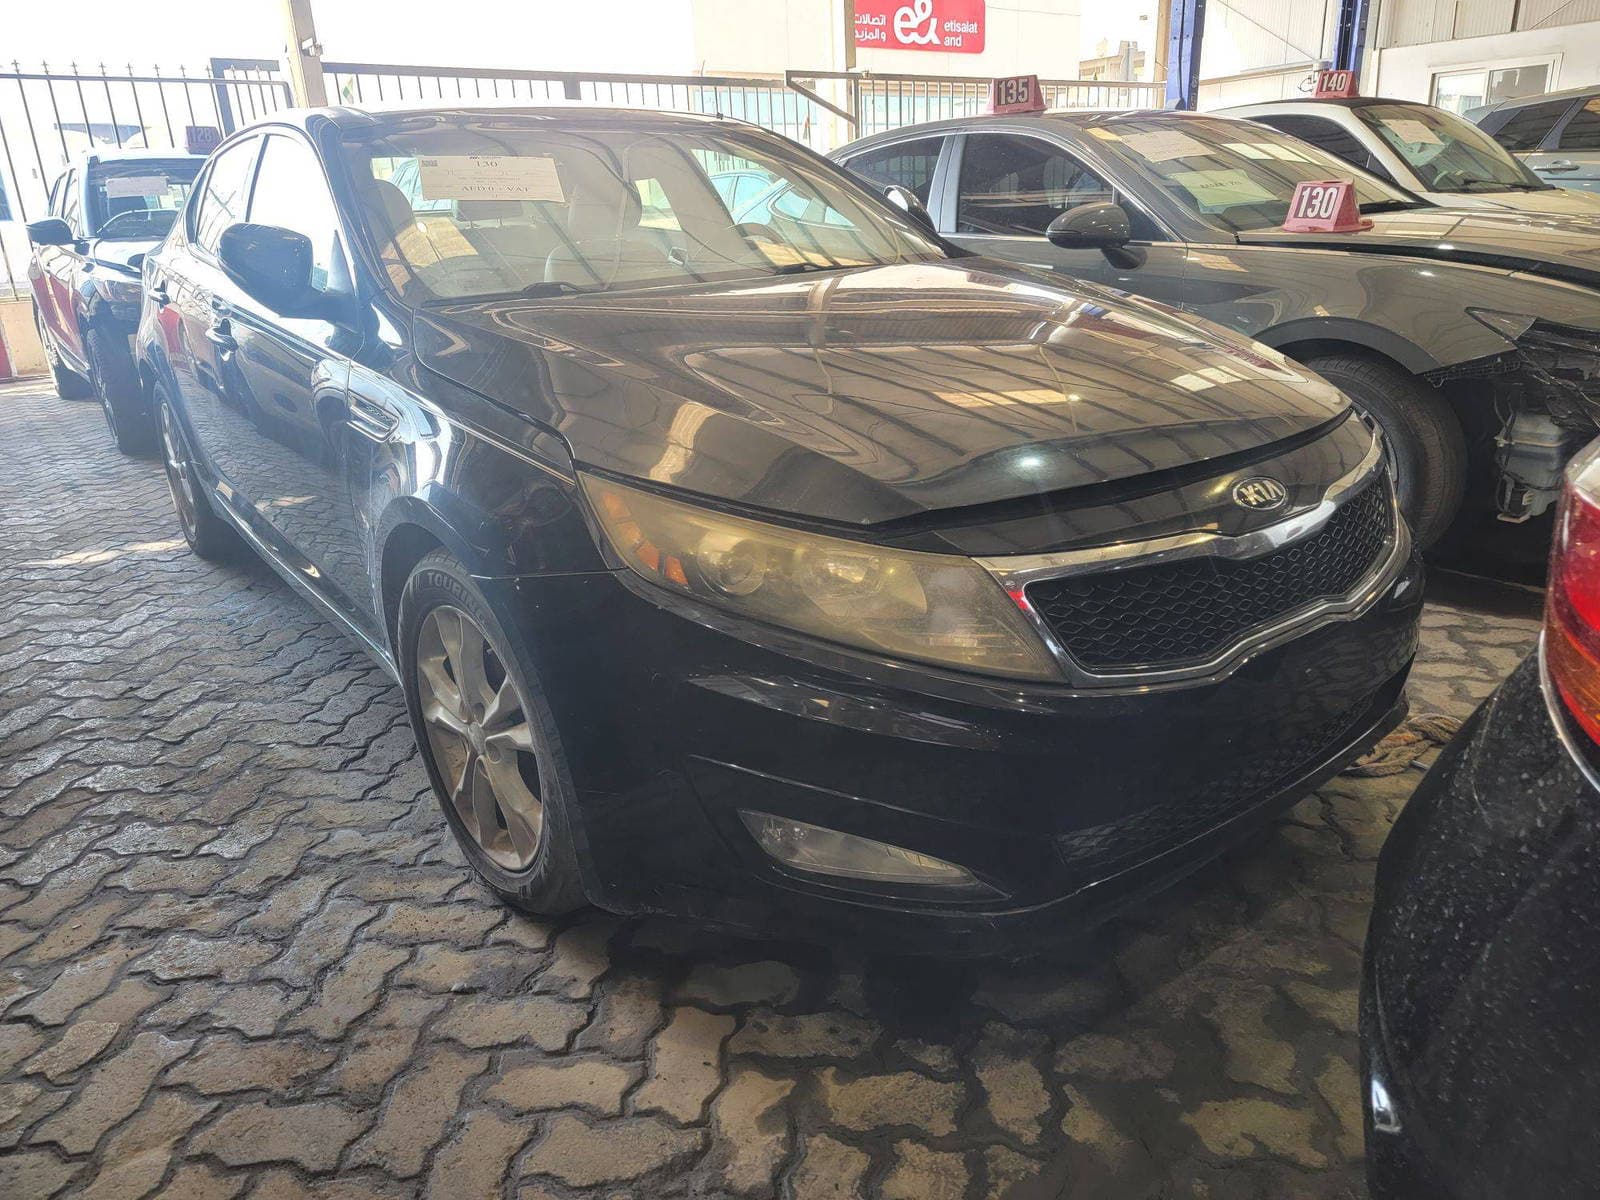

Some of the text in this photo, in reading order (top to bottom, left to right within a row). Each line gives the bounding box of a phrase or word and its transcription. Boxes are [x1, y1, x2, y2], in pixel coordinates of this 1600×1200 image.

[943, 20, 978, 33] etisalat
[943, 34, 963, 47] and
[999, 78, 1028, 105] 135
[1322, 72, 1347, 92] 140
[1298, 186, 1338, 218] 130
[1240, 480, 1284, 505] KIA
